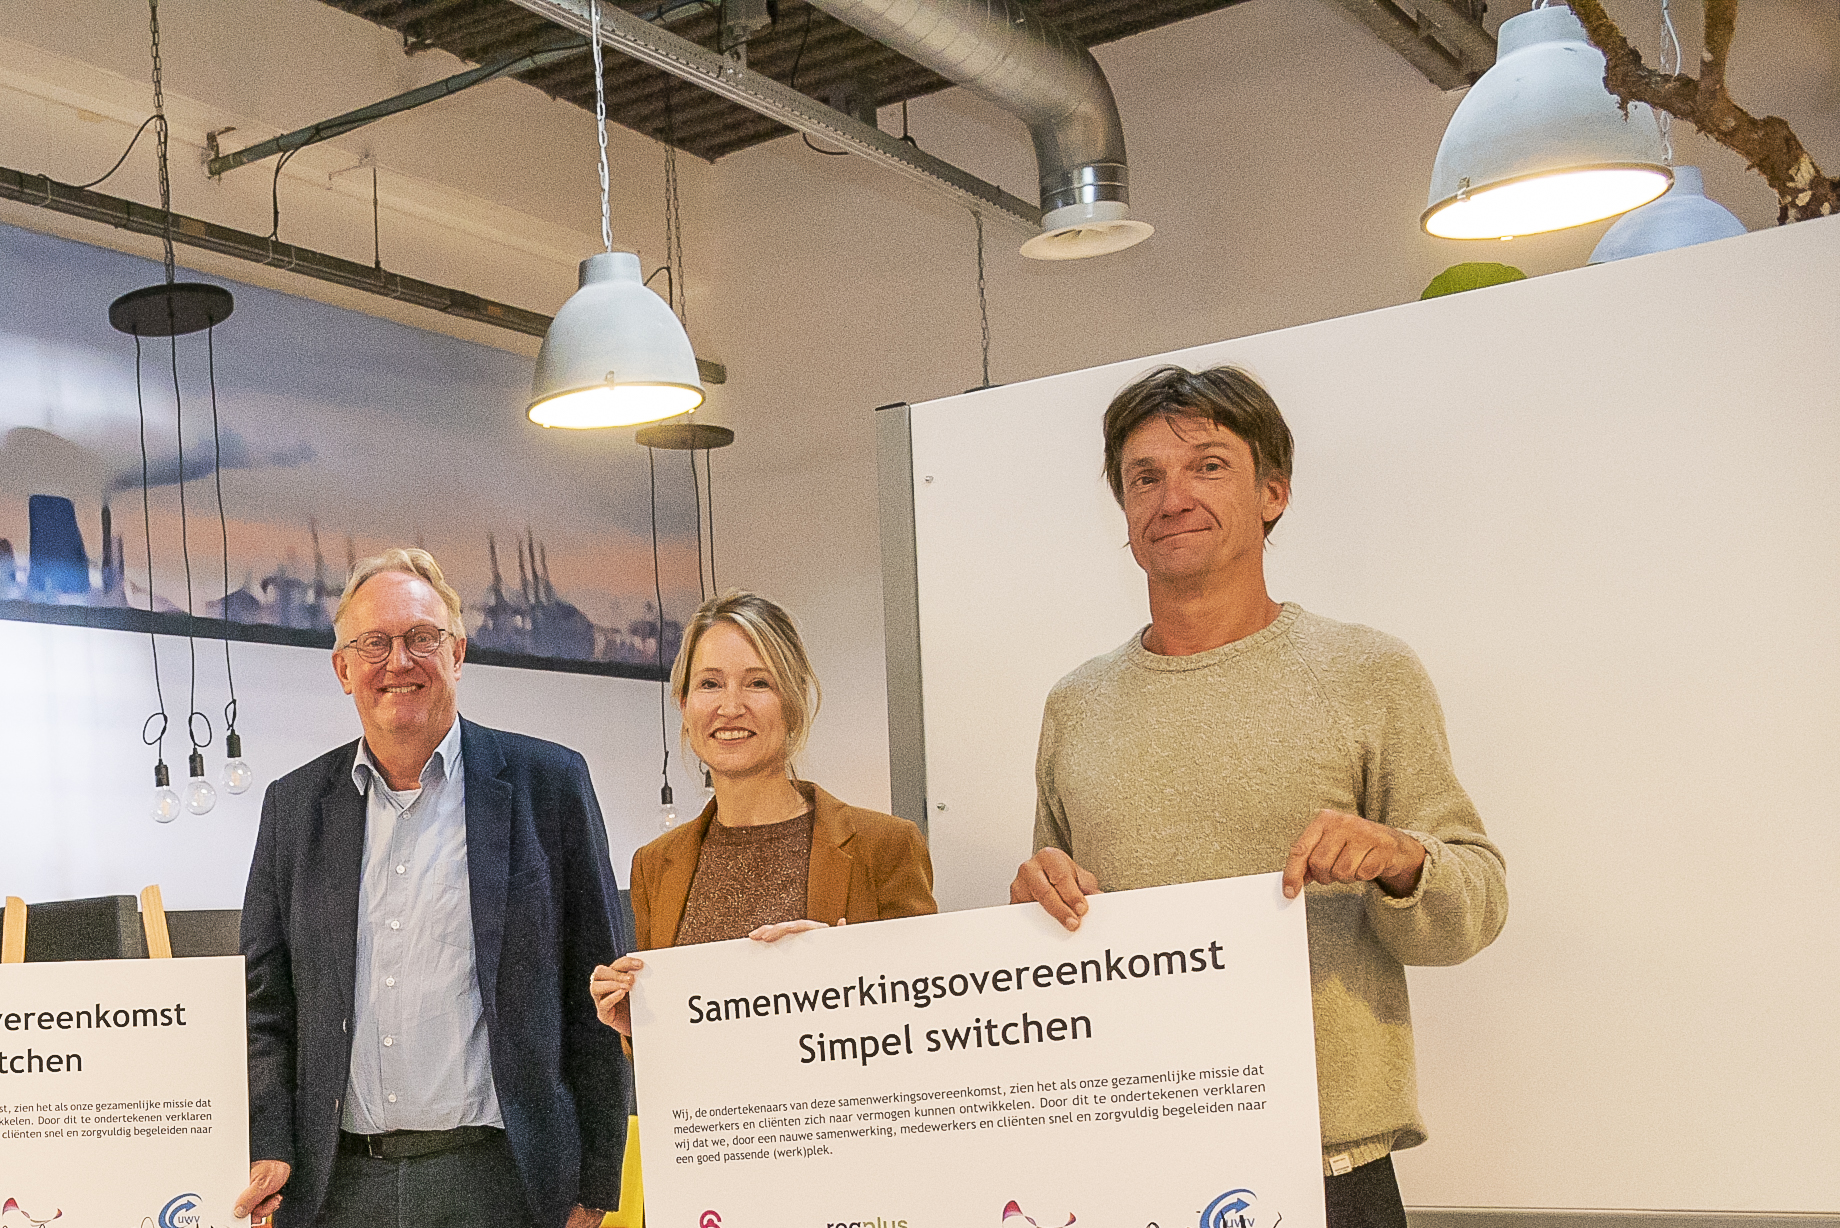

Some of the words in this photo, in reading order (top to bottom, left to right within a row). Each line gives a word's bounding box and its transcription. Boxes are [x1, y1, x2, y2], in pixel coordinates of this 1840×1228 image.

[689, 941, 1225, 1023] Samenwerkingsovereenkomst
[799, 1025, 913, 1066] Simpel
[926, 1015, 1091, 1052] switchen
[13, 1105, 34, 1113] zien
[36, 1102, 53, 1112] het
[54, 1102, 69, 1112] als
[69, 1103, 94, 1111] onze
[95, 1099, 161, 1113] gezamenlijke
[162, 1098, 194, 1109] missie
[195, 1098, 212, 1108] dat
[37, 1115, 61, 1125] Door
[63, 1115, 78, 1125] dit
[80, 1115, 91, 1124] te
[94, 1113, 163, 1124] ondertekenen
[165, 1111, 212, 1122] verklaren
[672, 1108, 693, 1122] Wij,
[694, 1107, 708, 1118] de
[709, 1103, 788, 1117] ondertekenaars
[789, 1101, 809, 1111] van
[810, 1098, 836, 1110] deze
[837, 1085, 1007, 1108] samenwerkingsovereenkomst,
[1009, 1084, 1035, 1094] zien
[1036, 1080, 1058, 1092] het
[1059, 1078, 1077, 1091] als
[1079, 1078, 1109, 1089] onze
[1111, 1069, 1196, 1089] gezamenlijke
[1199, 1068, 1240, 1080] missie
[1242, 1064, 1265, 1077] dat
[673, 1121, 740, 1135] medewerkers
[742, 1121, 756, 1130] en
[758, 1117, 801, 1129] cliënten
[804, 1113, 826, 1126] zich
[829, 1113, 853, 1124] naar
[856, 1109, 911, 1122] vermogen
[914, 1106, 956, 1117] kunnen
[959, 1099, 1035, 1114] ontwikkelen.
[1039, 1097, 1068, 1109] Door
[1072, 1094, 1090, 1106] dit
[1093, 1094, 1107, 1105] te
[1110, 1088, 1199, 1104] ondertekenen
[1202, 1082, 1266, 1096] verklaren
[1, 1129, 42, 1139] cliënten
[44, 1128, 64, 1138] snel
[66, 1130, 79, 1138] en
[81, 1126, 132, 1139] zorgvuldig
[133, 1125, 188, 1138] begeleiden
[190, 1126, 213, 1134] naar
[674, 1140, 690, 1152] wij
[692, 1137, 709, 1148] dat
[710, 1138, 730, 1148] we,
[732, 1135, 755, 1146] door
[757, 1134, 777, 1144] een
[779, 1132, 814, 1143] nauwe
[815, 1125, 897, 1140] samenwerking,
[900, 1119, 977, 1134] medewerkers
[979, 1119, 994, 1129] en
[996, 1116, 1046, 1128] cliënten
[1048, 1111, 1074, 1125] snel
[1076, 1113, 1092, 1123] en
[1094, 1106, 1160, 1123] zorgvuldig
[1162, 1101, 1234, 1118] begeleiden
[1237, 1100, 1267, 1112] naar
[675, 1155, 694, 1164] een
[696, 1151, 721, 1166] goed
[723, 1148, 770, 1164] passende
[773, 1144, 833, 1160] (werk)plek.
